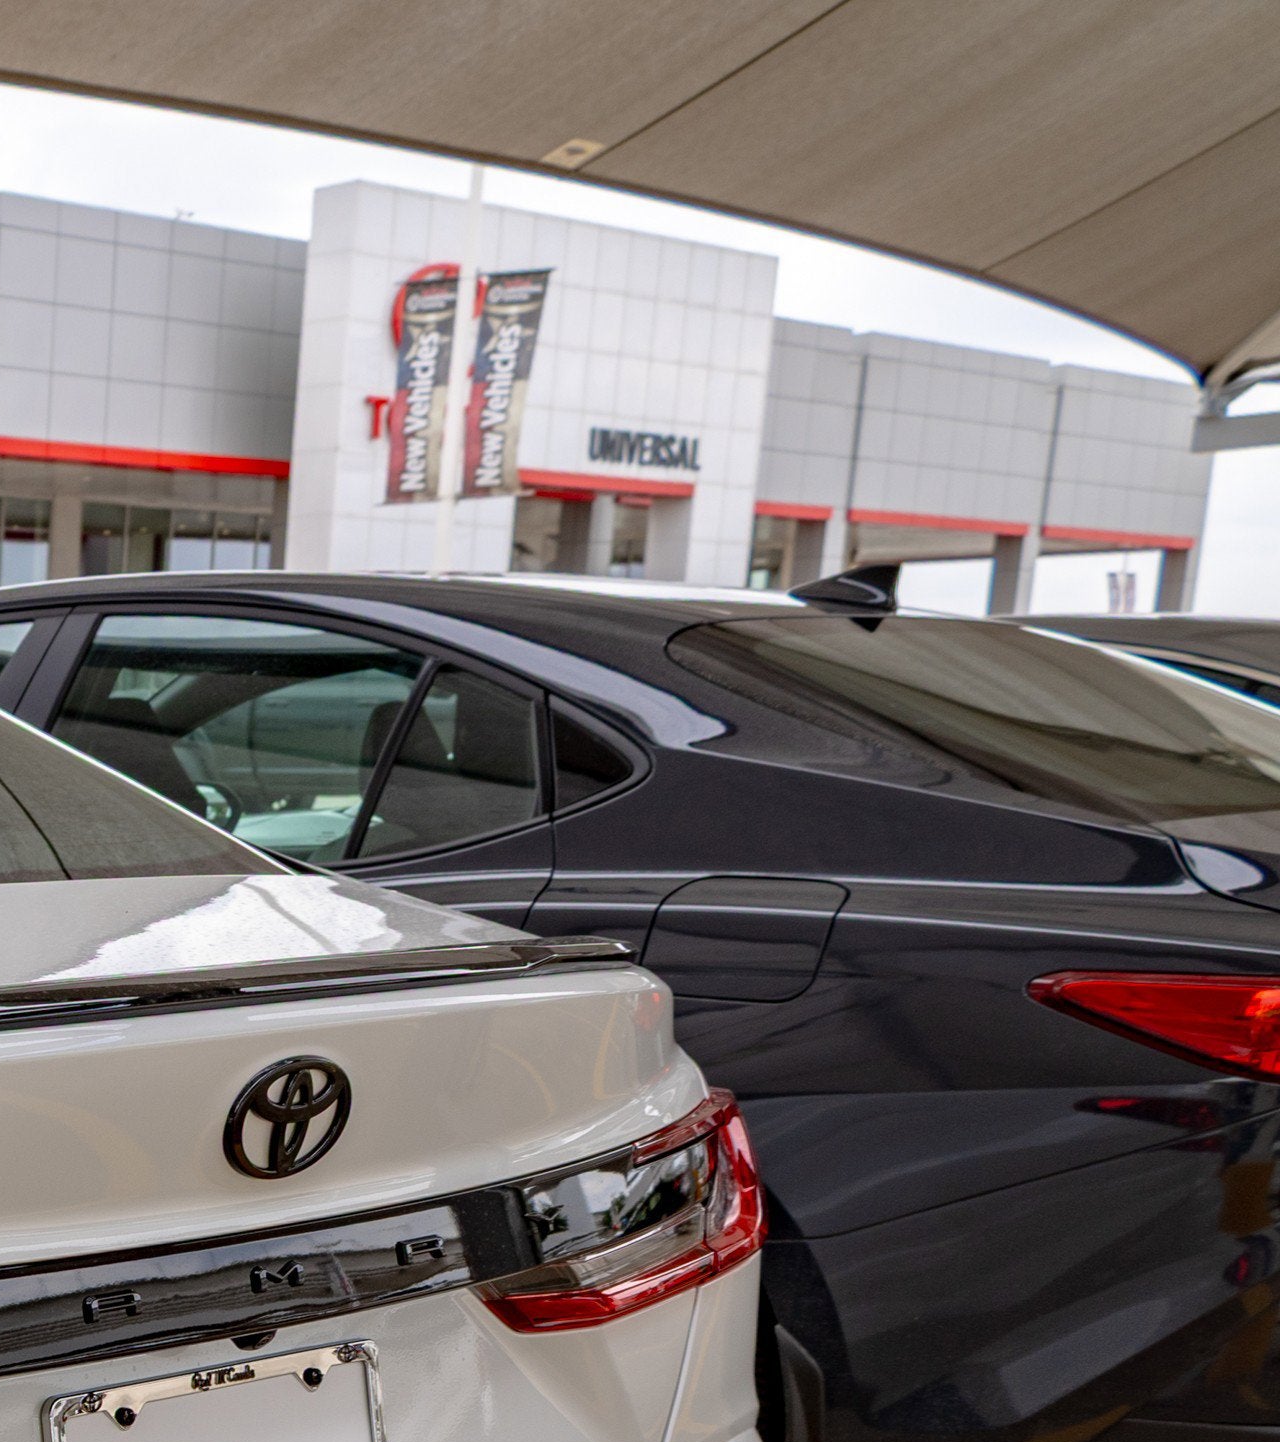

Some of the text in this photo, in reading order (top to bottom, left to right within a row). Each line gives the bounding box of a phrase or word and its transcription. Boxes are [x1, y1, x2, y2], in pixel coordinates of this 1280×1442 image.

[403, 330, 441, 436] Vehicles
[479, 322, 523, 430] Vehicles
[399, 437, 427, 493] New
[474, 431, 505, 488] New
[589, 427, 701, 471] UNIVERSAL
